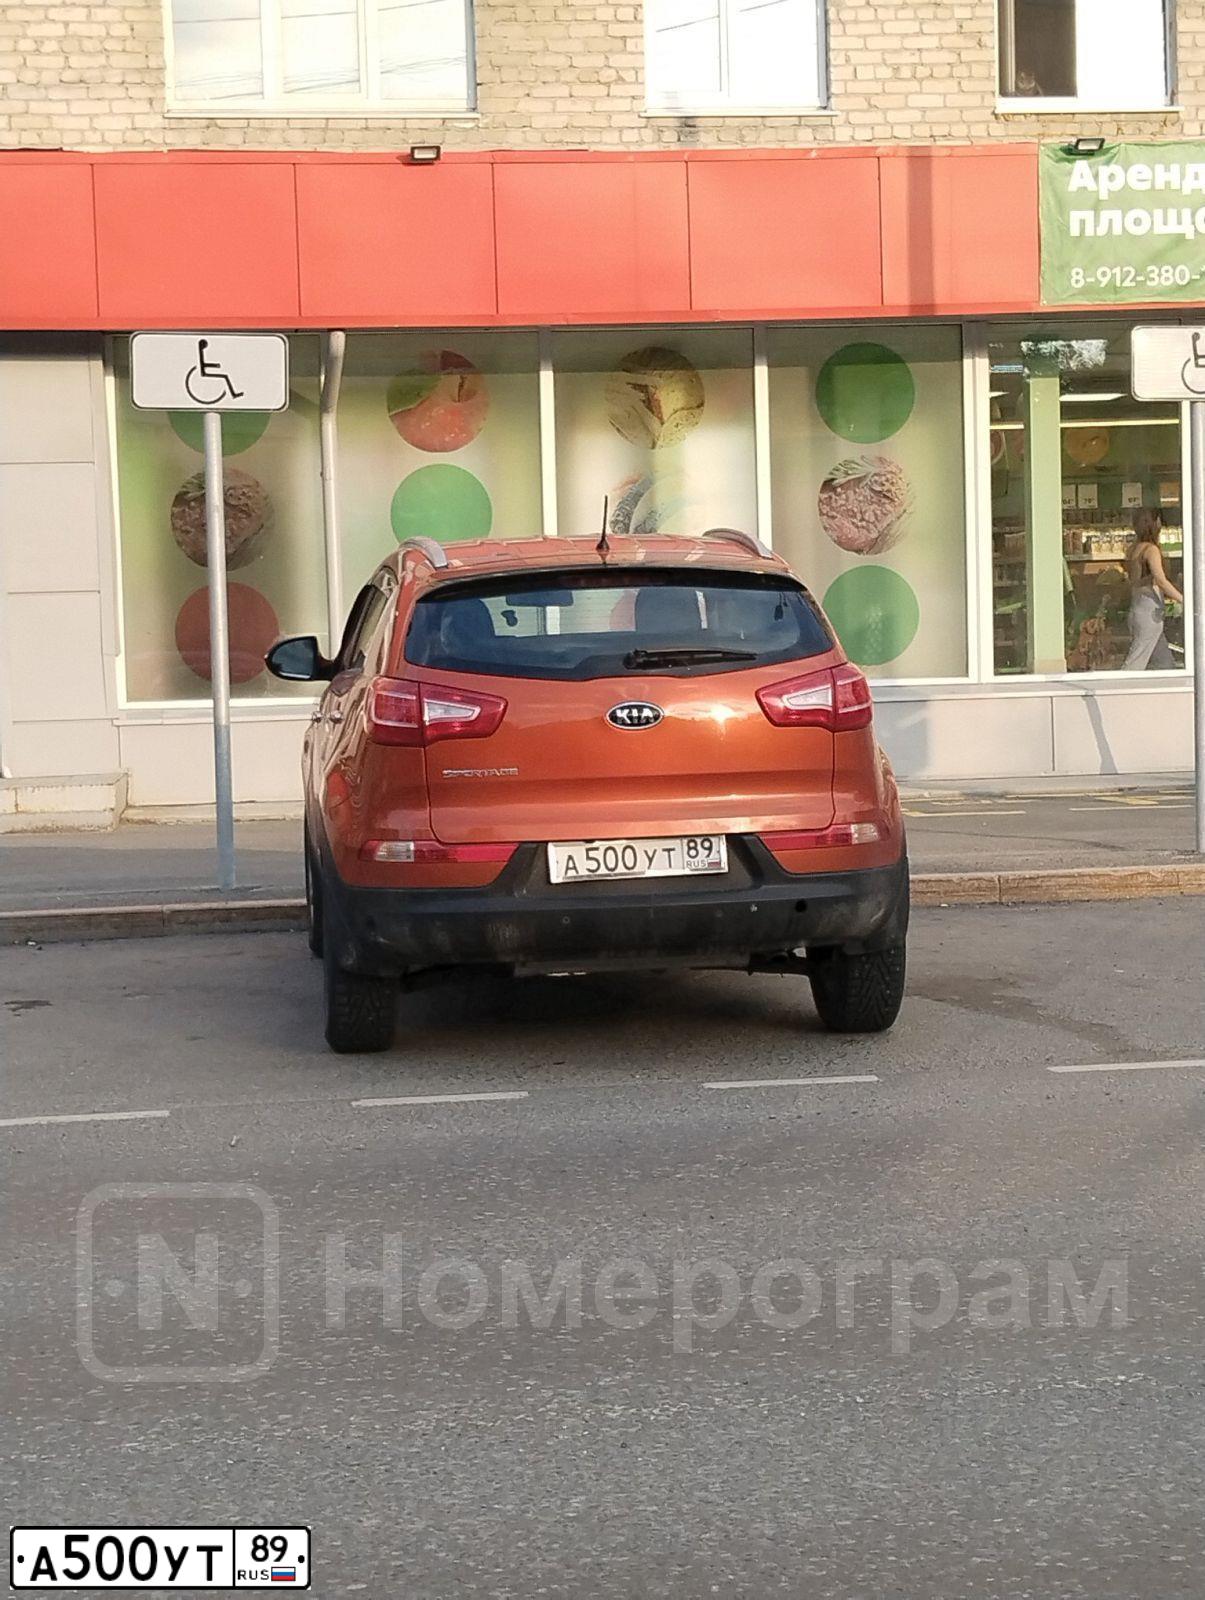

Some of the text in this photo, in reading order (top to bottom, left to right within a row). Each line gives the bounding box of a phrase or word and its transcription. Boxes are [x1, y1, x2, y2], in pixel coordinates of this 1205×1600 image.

[1068, 160, 1205, 200] Аренд
[1070, 264, 1205, 288] 8-912-380-
[615, 708, 657, 724] KIA
[686, 837, 713, 859] 89
[686, 859, 707, 868] RUS
